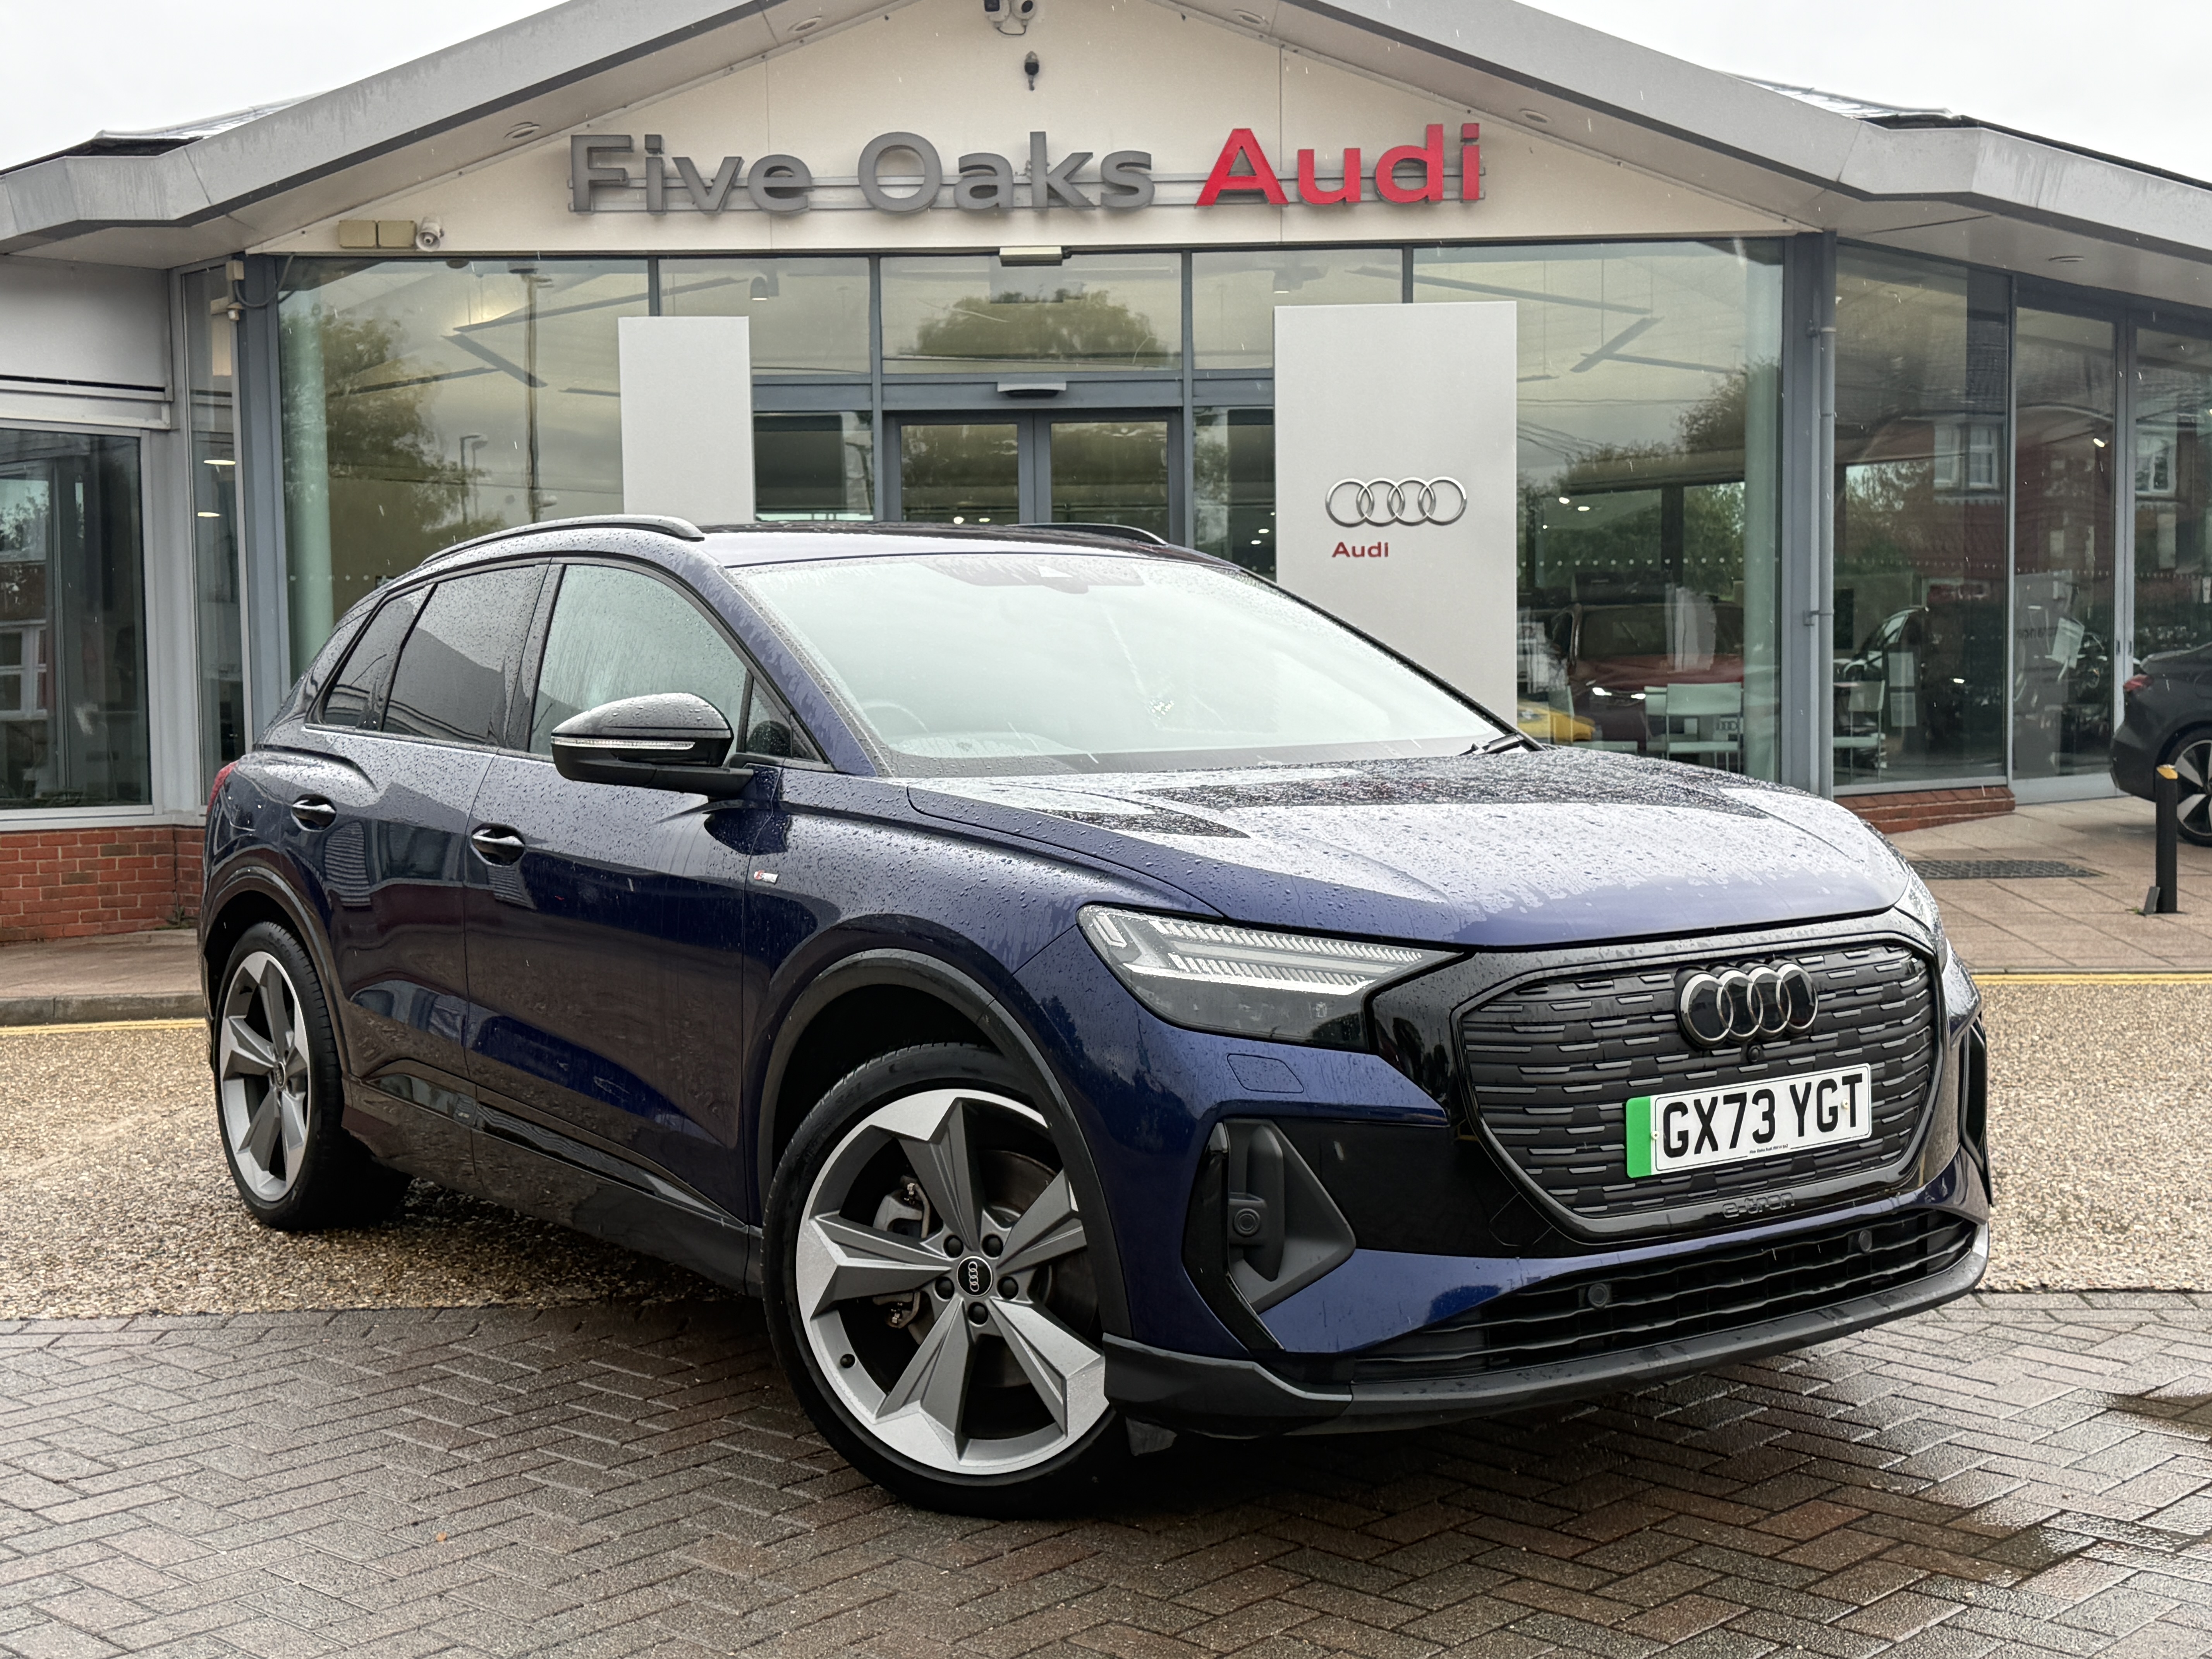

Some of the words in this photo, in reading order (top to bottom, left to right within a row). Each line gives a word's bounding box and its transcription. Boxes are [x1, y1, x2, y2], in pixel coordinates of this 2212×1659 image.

[570, 134, 813, 213] Five
[857, 131, 1156, 211] Oaks
[1194, 123, 1480, 206] Audi
[1331, 541, 1389, 558] Audi
[1662, 1088, 1775, 1158] GX73
[1789, 1073, 1863, 1137] YGT
[1723, 1192, 1795, 1218] e-tron
